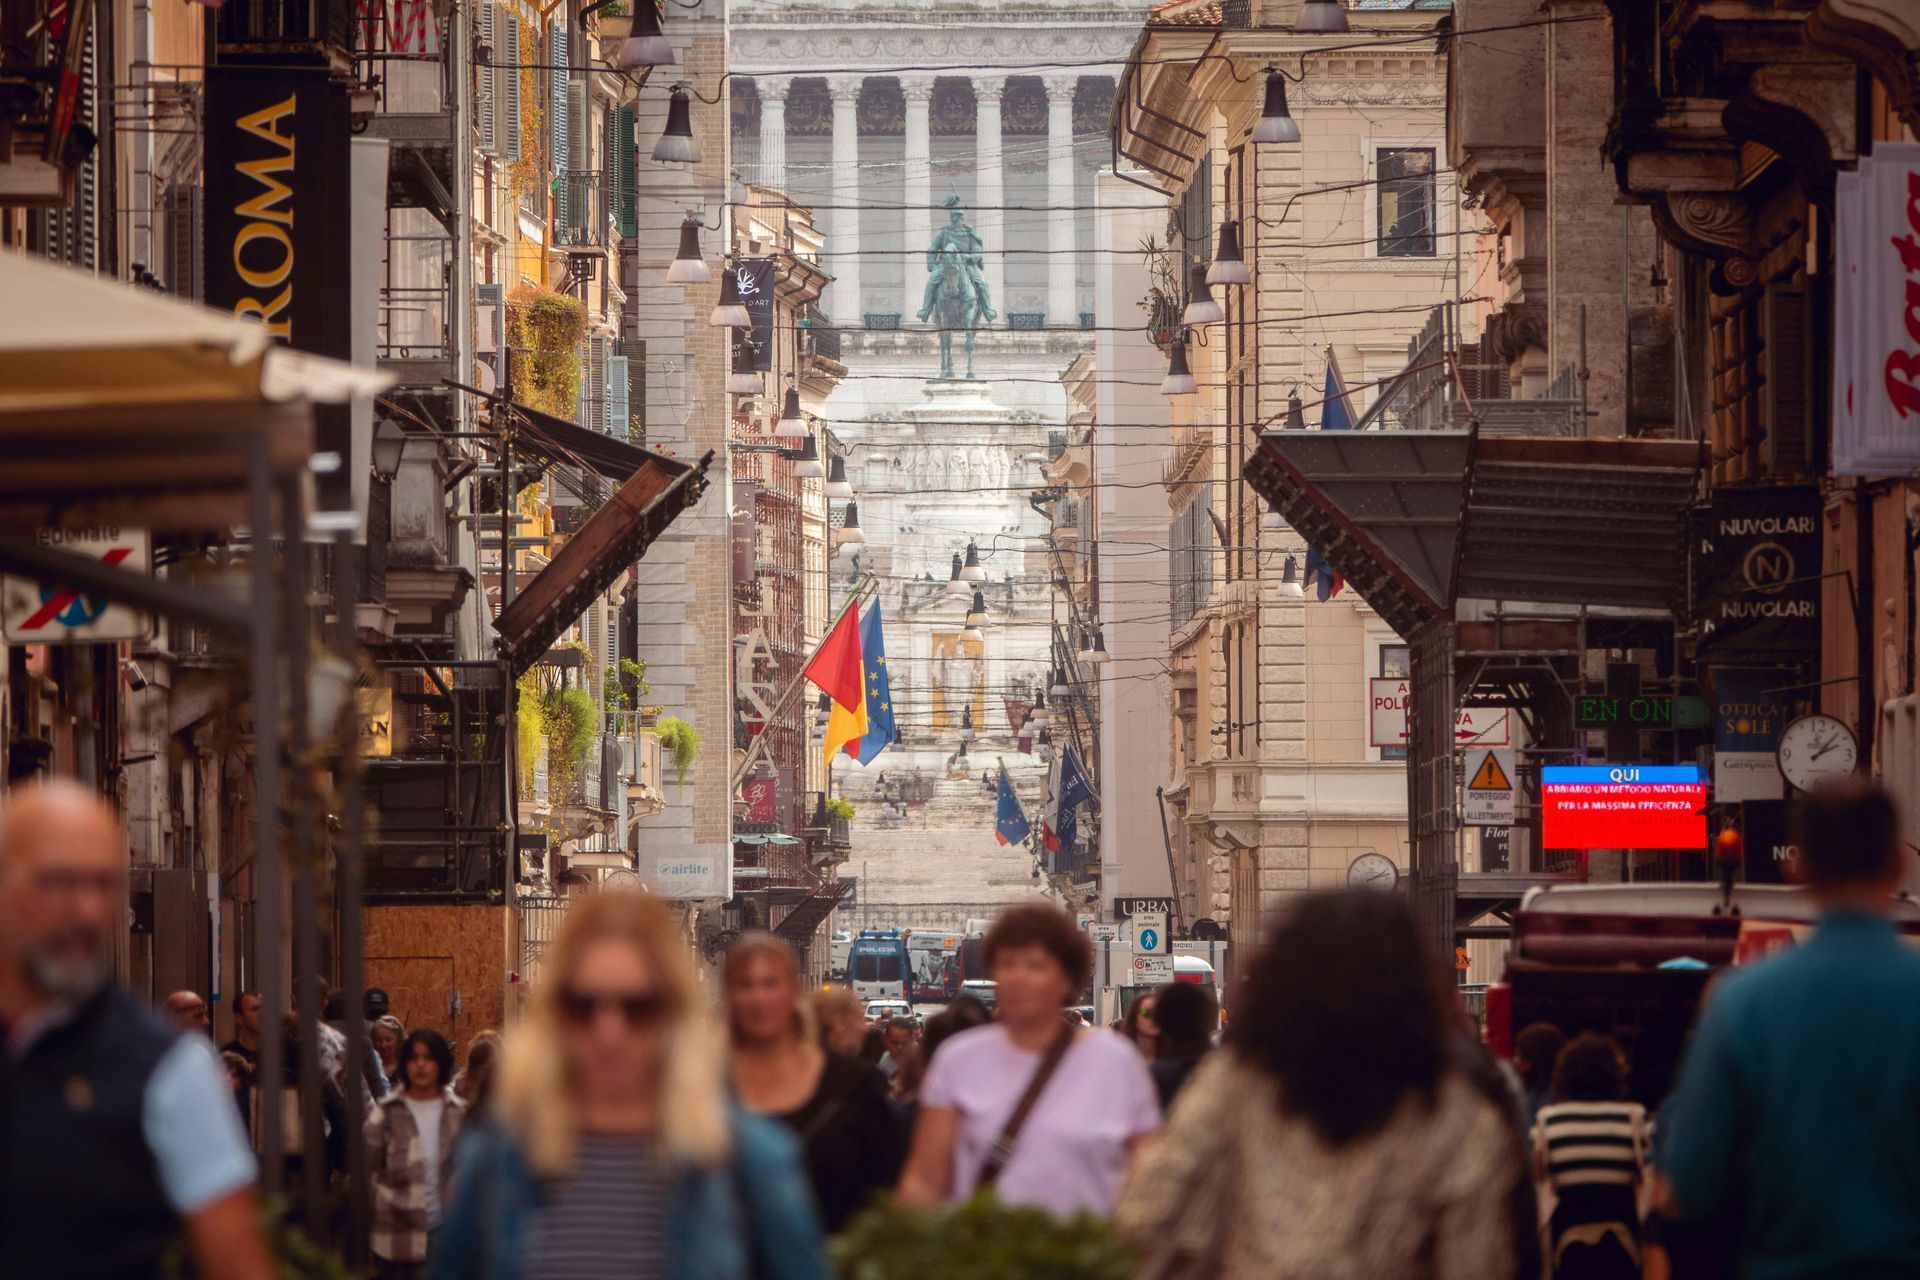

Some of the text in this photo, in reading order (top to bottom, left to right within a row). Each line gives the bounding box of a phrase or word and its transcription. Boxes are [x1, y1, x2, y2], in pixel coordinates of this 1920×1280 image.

[233, 91, 296, 343] ROMA
[1719, 703, 1778, 716] OTTICA
[1609, 768, 1640, 783] QUI
[1547, 785, 1702, 794] ABBIAMO UN METODO NATURALE
[1469, 792, 1511, 801] PONTEGGIO
[1557, 801, 1692, 810] PER LA MASSIMA EFFICIENZA
[1467, 812, 1513, 820] ALLESTIMENTO
[859, 945, 896, 953] POLIZIA
